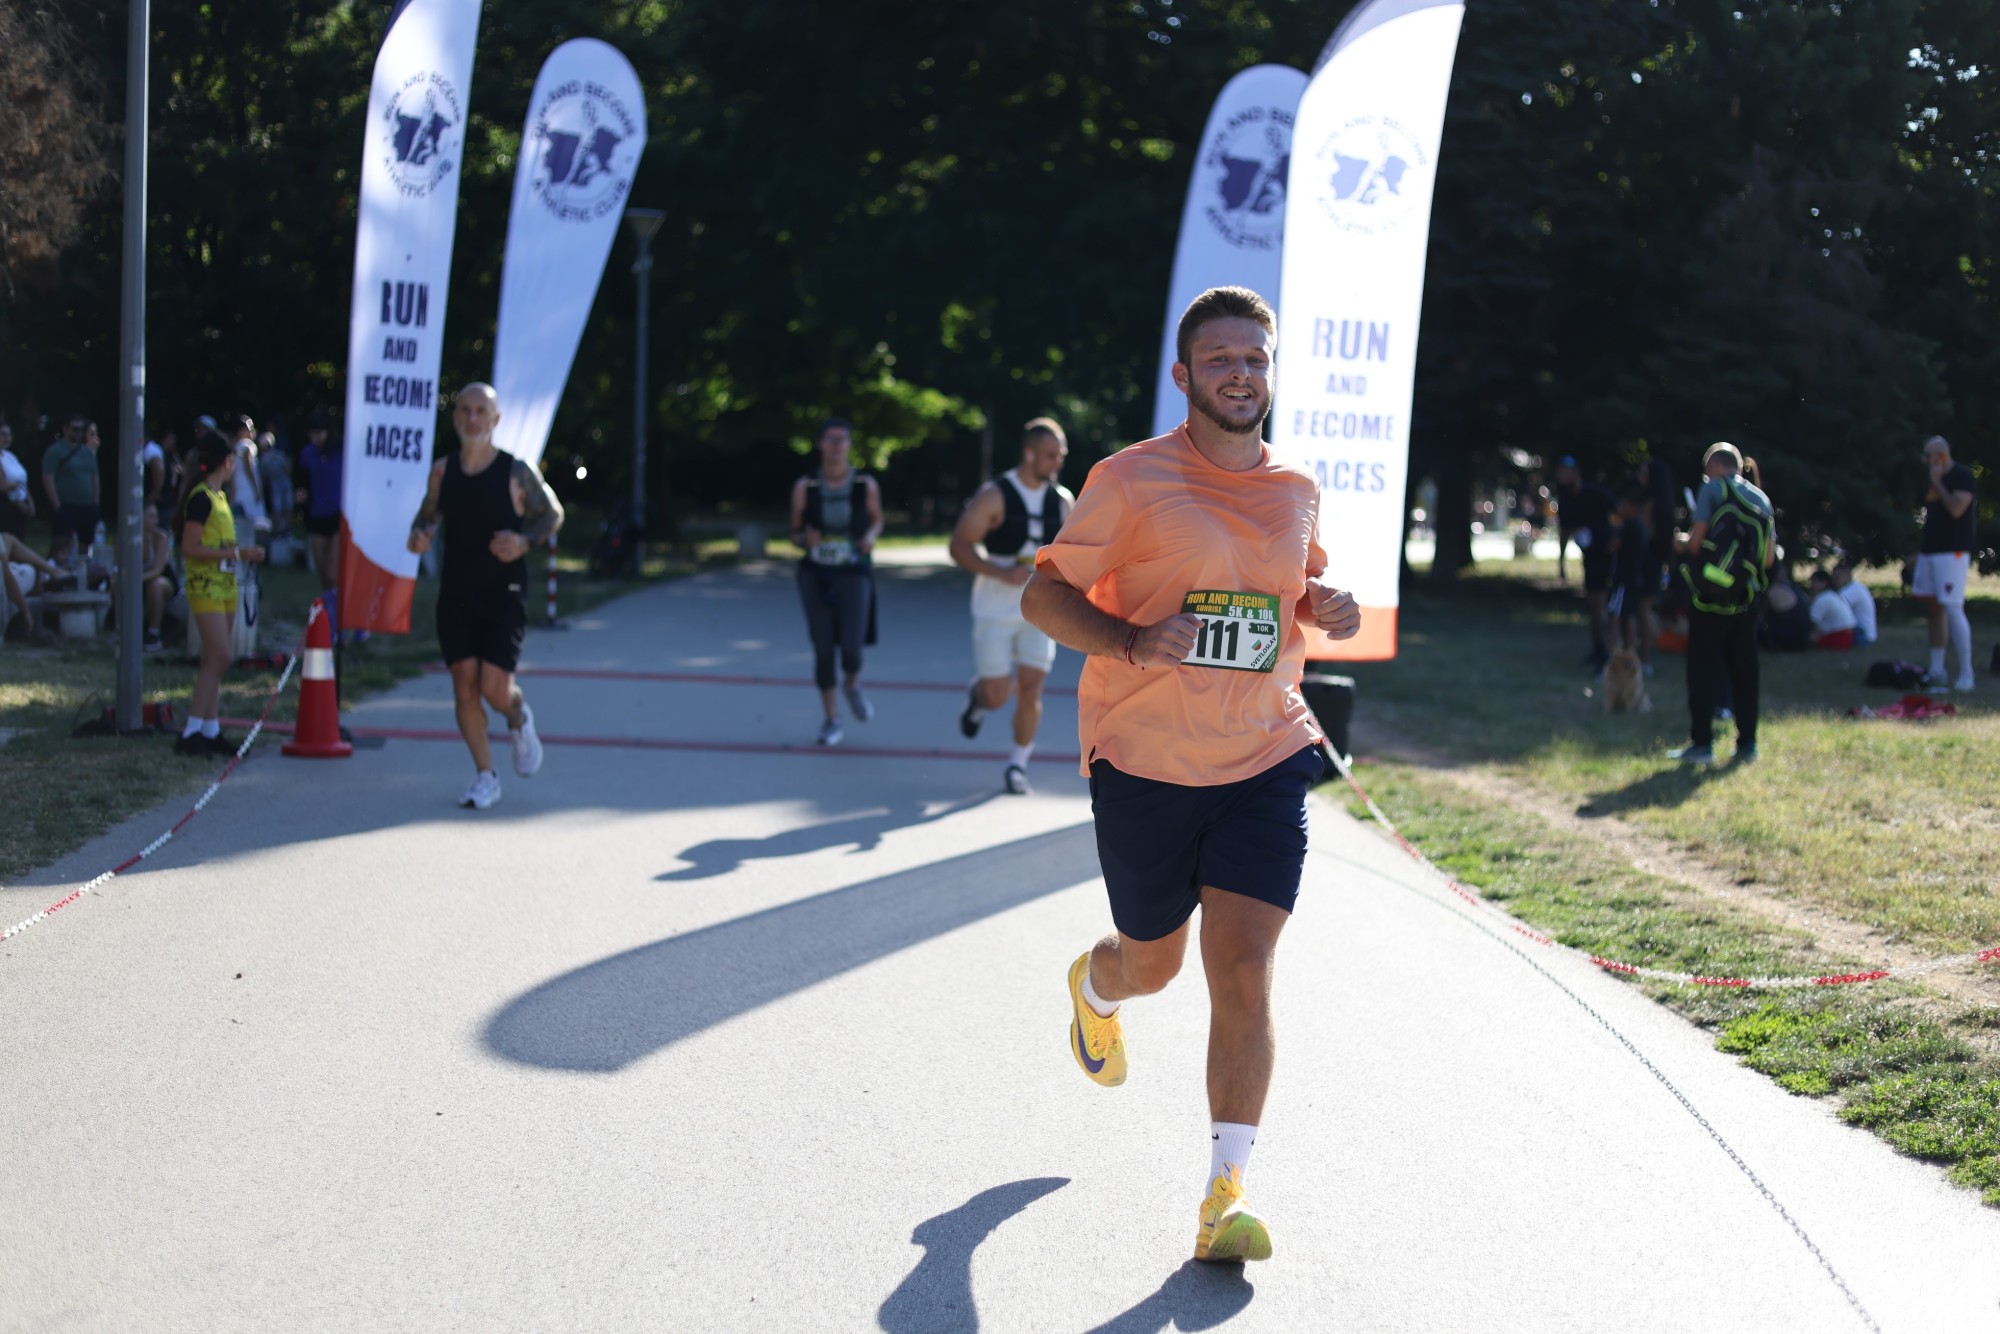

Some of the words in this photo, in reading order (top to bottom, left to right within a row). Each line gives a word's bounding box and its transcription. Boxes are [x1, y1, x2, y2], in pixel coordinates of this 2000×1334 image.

[380, 279, 429, 328] RUN
[383, 336, 417, 364] AND
[1312, 317, 1389, 362] RUN
[1325, 373, 1368, 396] AND
[1293, 410, 1395, 442] BECOME
[1305, 459, 1386, 493] ACES
[1187, 592, 1206, 604] RUN
[1207, 593, 1229, 606] AND
[1232, 594, 1269, 609] BECOME
[1196, 604, 1222, 614] SUNRISE
[1228, 605, 1243, 618] 5K
[1246, 609, 1254, 619] &
[1258, 609, 1274, 621] 10K
[1196, 618, 1240, 661] 111
[1257, 624, 1269, 633] 10K
[1250, 635, 1277, 668] SVETLOSLAV
